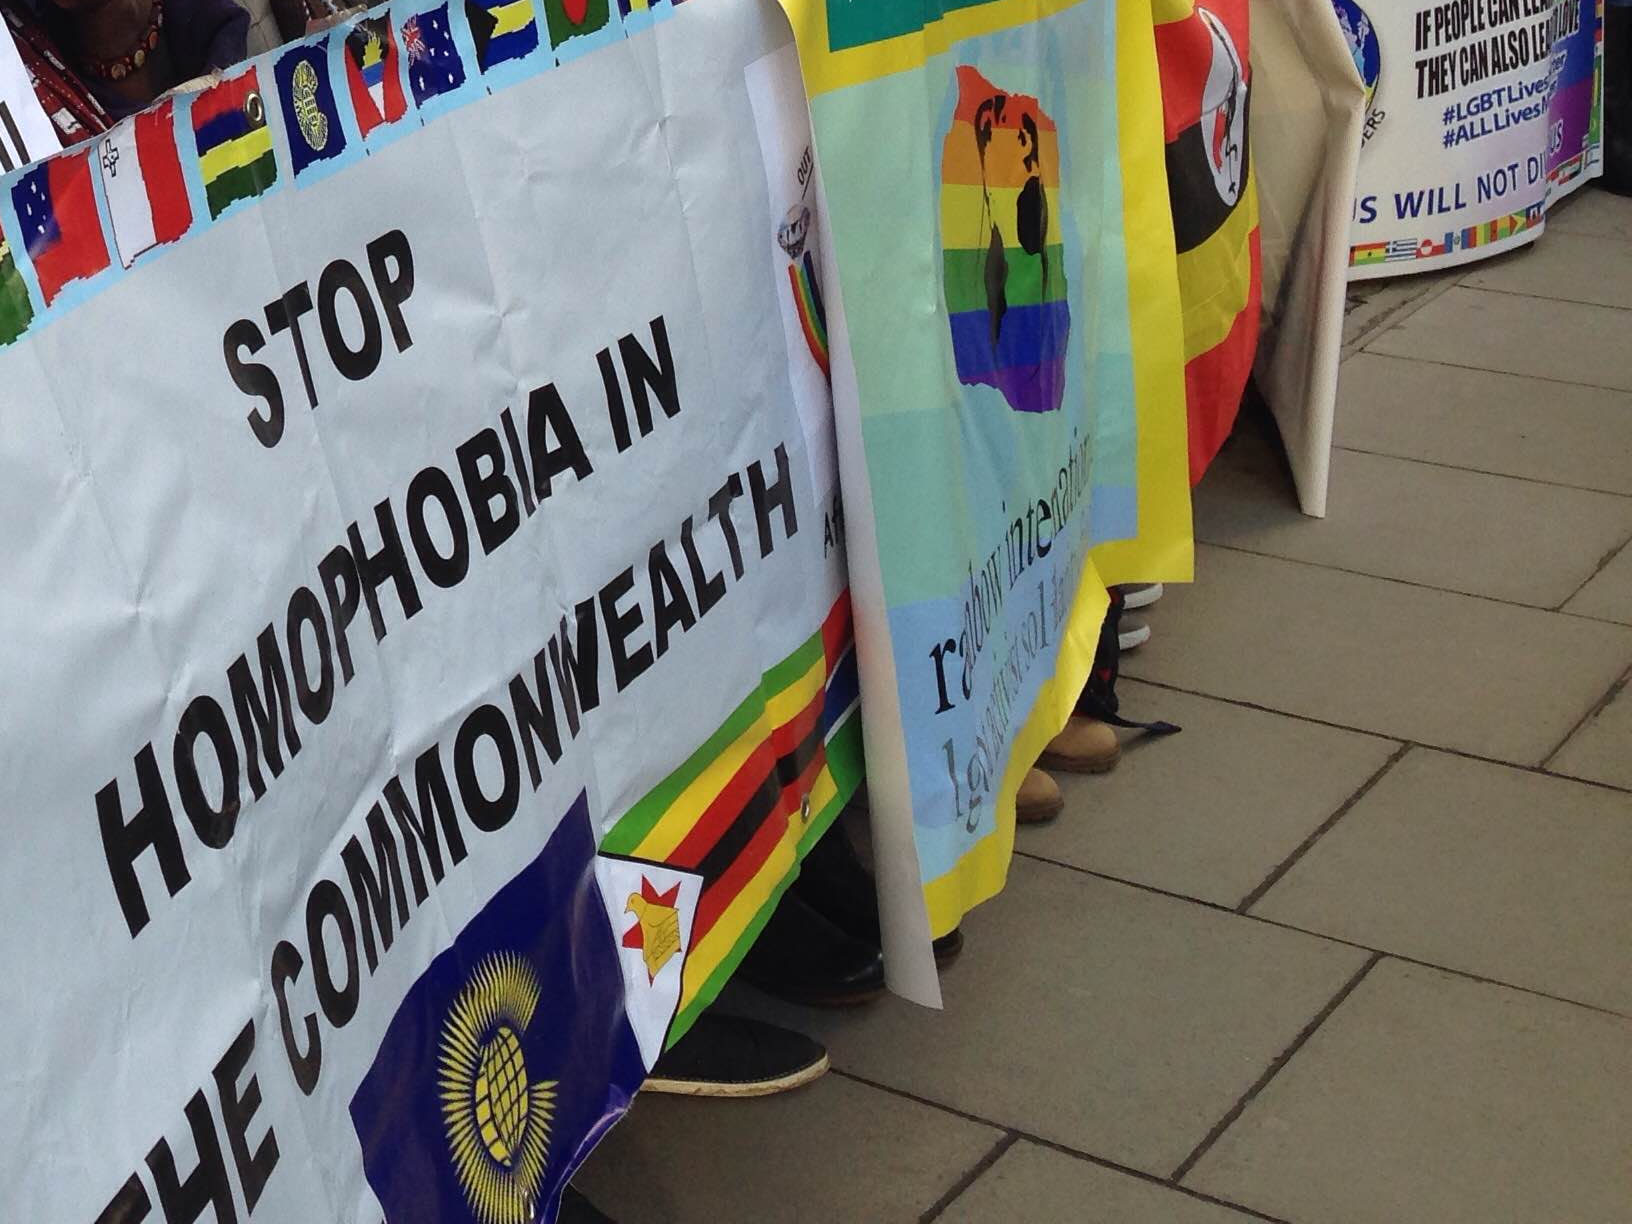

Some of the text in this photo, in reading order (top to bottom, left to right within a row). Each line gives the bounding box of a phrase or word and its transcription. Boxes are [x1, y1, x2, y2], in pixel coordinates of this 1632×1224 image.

[1415, 9, 1432, 52] IF
[1415, 49, 1458, 99] THEY
[1459, 39, 1491, 88] CAN
[1491, 27, 1530, 77] ALSO
[1395, 187, 1467, 221] WILL
[1478, 161, 1521, 204] NOT
[223, 229, 415, 449] STOP
[94, 382, 593, 939] HOMOPHOBIA
[595, 315, 682, 454] IN
[271, 442, 799, 1096] COMMONWEALTH
